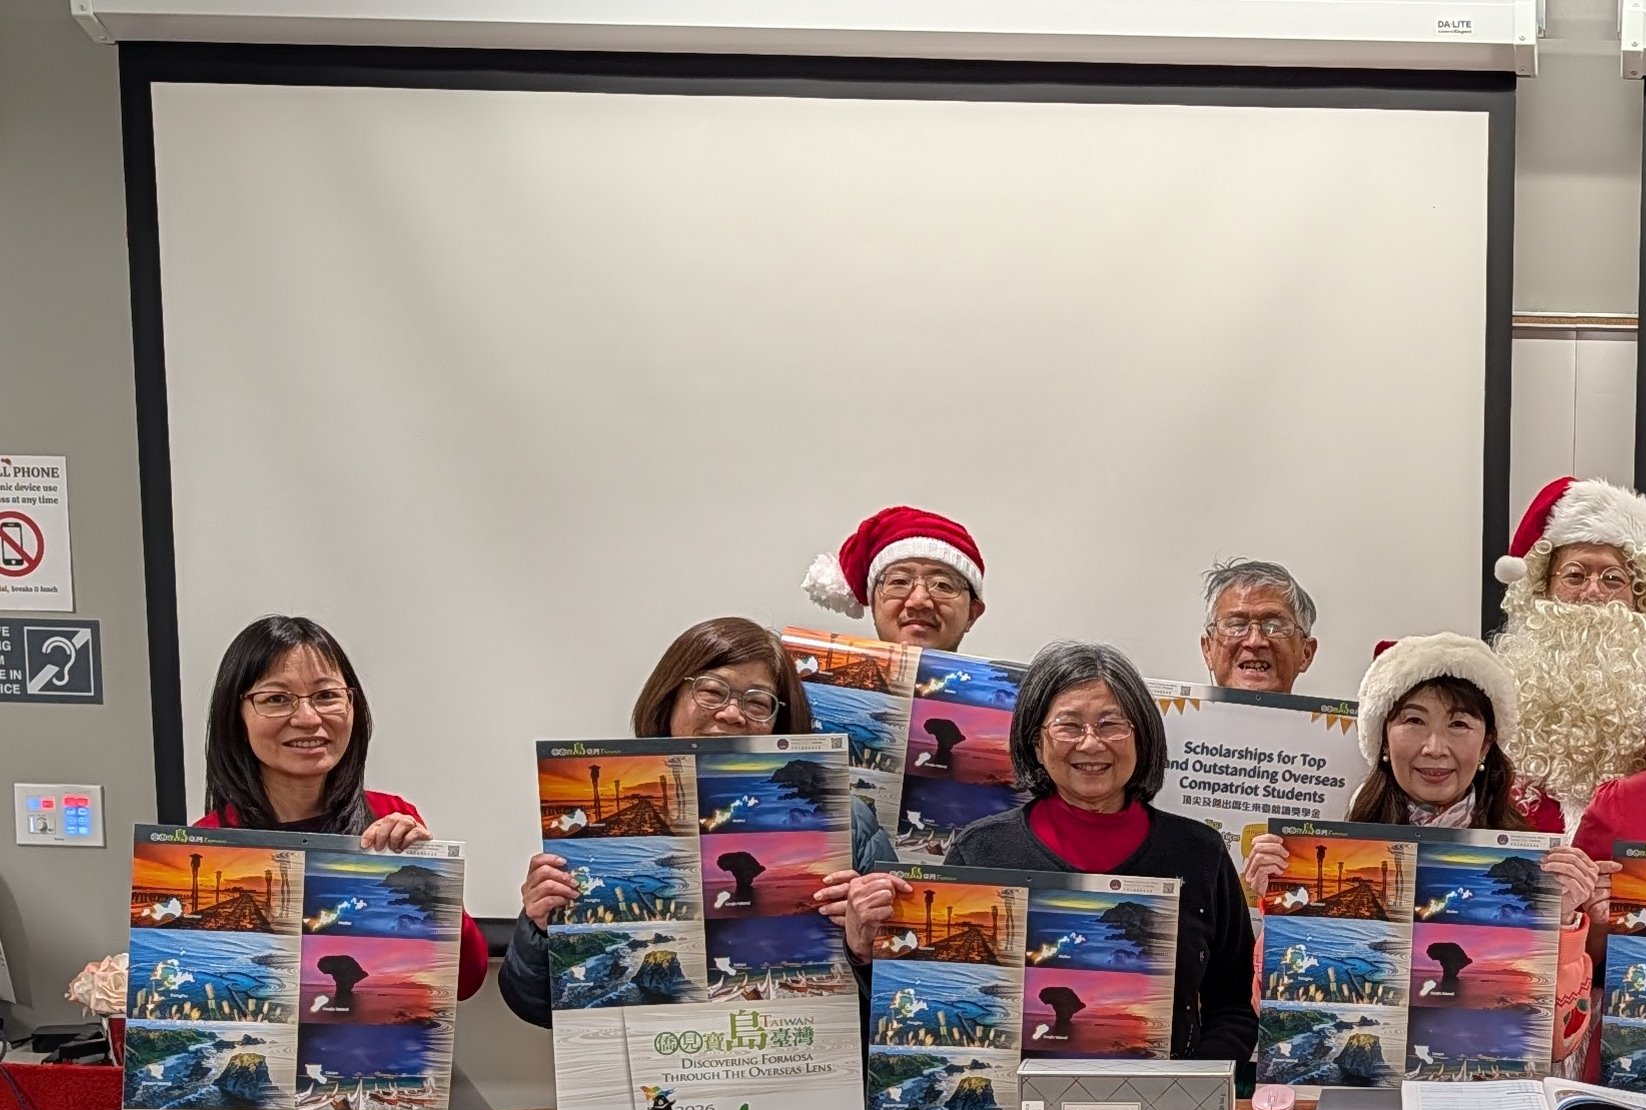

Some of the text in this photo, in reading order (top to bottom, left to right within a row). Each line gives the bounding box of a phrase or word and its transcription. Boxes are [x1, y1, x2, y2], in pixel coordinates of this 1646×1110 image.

[13, 467, 60, 478] PHONE
[14, 483, 41, 492] device
[21, 497, 37, 505] any
[38, 496, 59, 504] time
[10, 670, 22, 680] IN
[1183, 741, 1326, 770] Scholarships for Top
[1192, 759, 1279, 784] Outstanding
[1282, 769, 1346, 788] Overseas
[1179, 776, 1326, 804] Compatriot Students
[759, 1013, 815, 1028] TAIWAN
[681, 1052, 814, 1070] DISCOVERING FORMOSA
[661, 1062, 832, 1083] THROUGH THE OVERSEAS LENS
